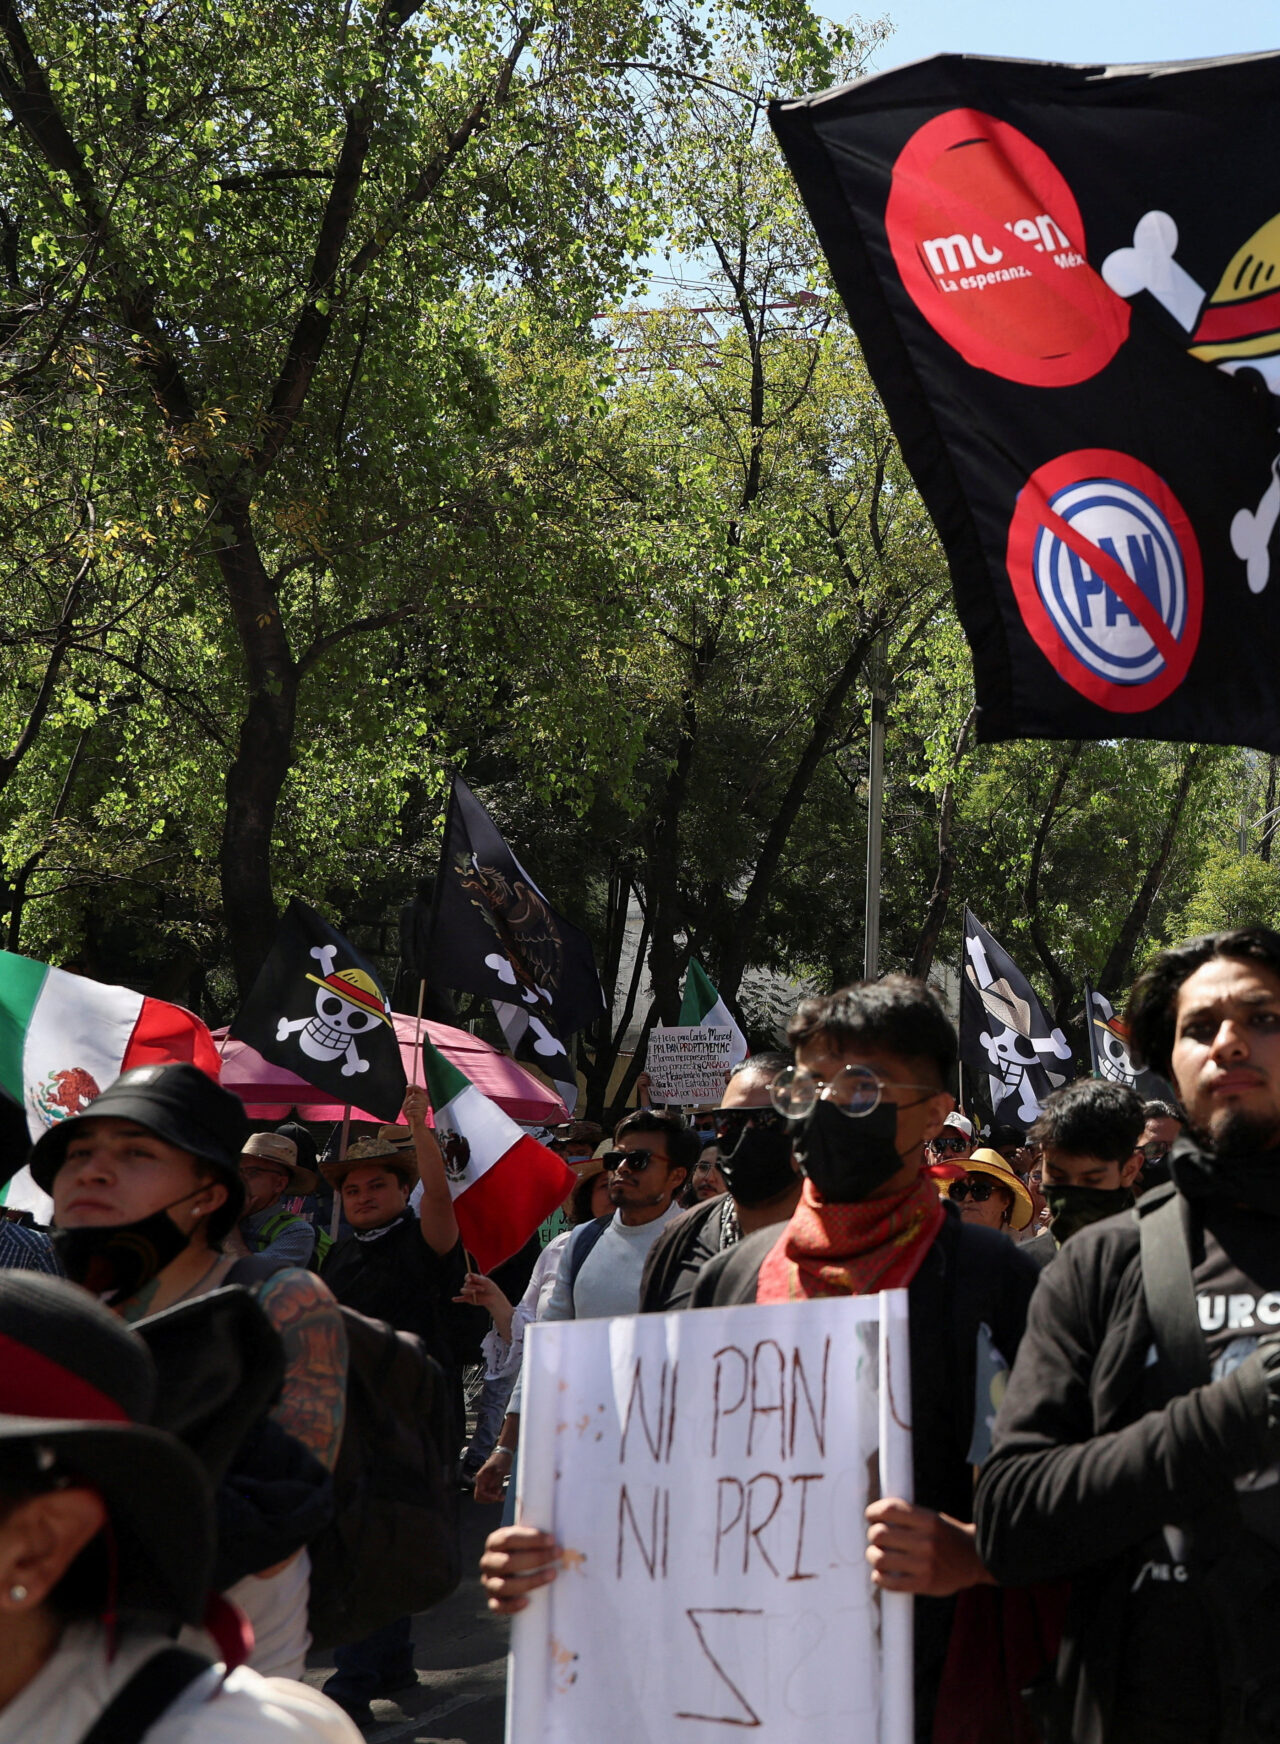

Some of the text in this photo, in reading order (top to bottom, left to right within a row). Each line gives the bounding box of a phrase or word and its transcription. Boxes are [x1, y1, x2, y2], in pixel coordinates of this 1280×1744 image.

[939, 277, 959, 292] La
[960, 266, 1032, 291] esperanz
[1066, 534, 1163, 628] PAN
[619, 1357, 679, 1464] NI
[711, 1333, 831, 1461] PAN
[617, 1472, 825, 1582] NI PRI
